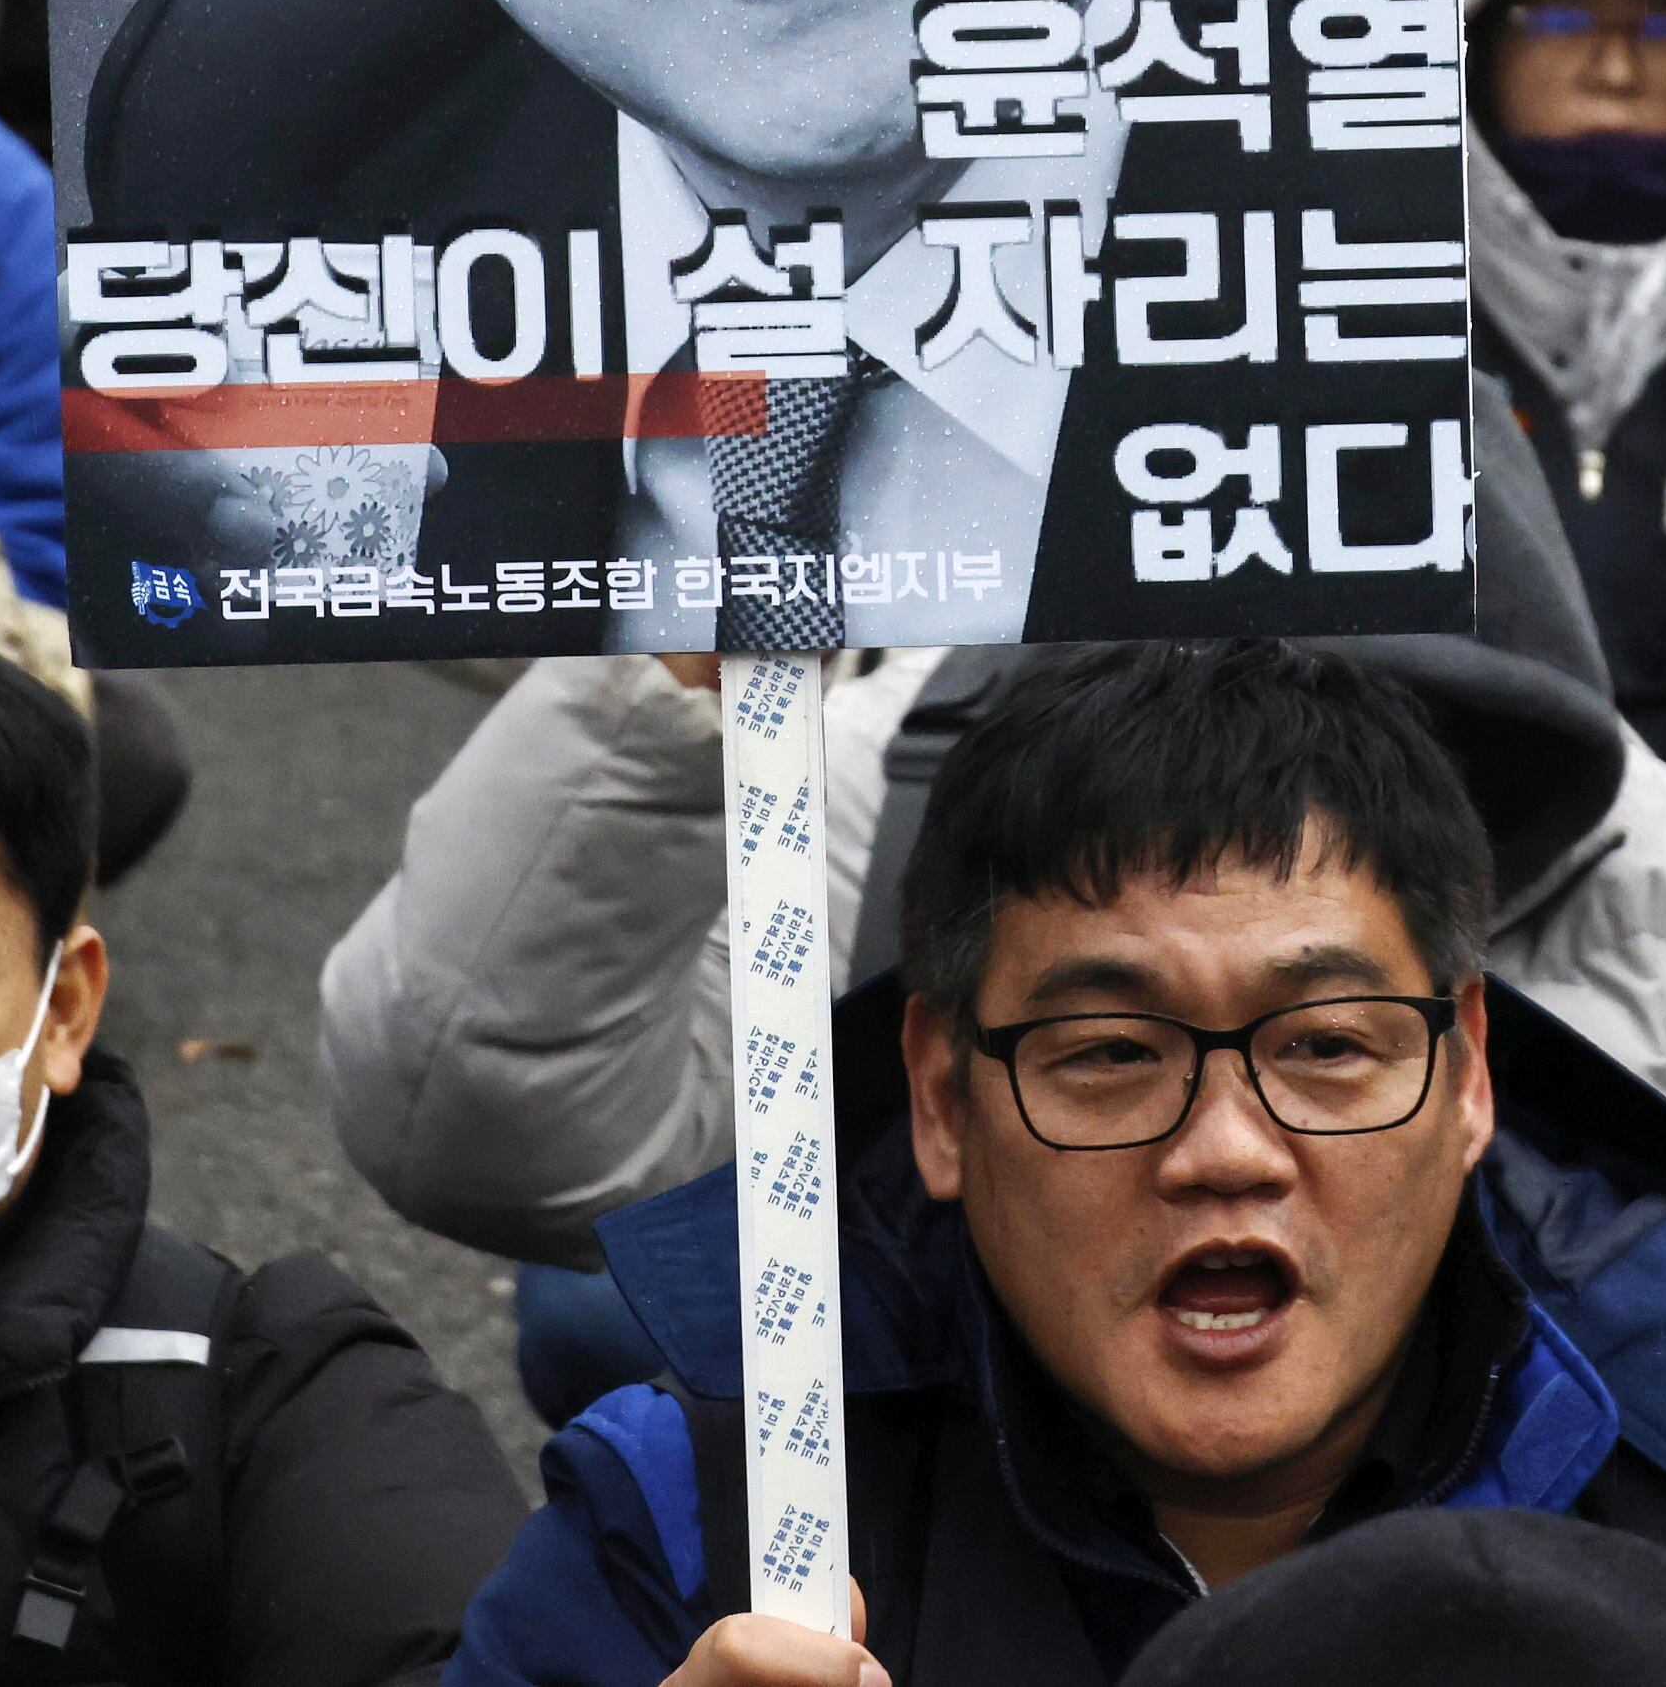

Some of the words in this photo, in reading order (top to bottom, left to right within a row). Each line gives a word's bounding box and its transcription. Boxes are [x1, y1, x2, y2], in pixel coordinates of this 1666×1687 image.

[66, 226, 600, 398] 당신이
[675, 212, 849, 380] 설
[919, 202, 1467, 374] 자리는
[1115, 419, 1473, 582] 없다
[151, 569, 192, 607] 금속
[219, 555, 658, 620] 전국금속노동조합
[673, 549, 1002, 610] 한국지엠지부
